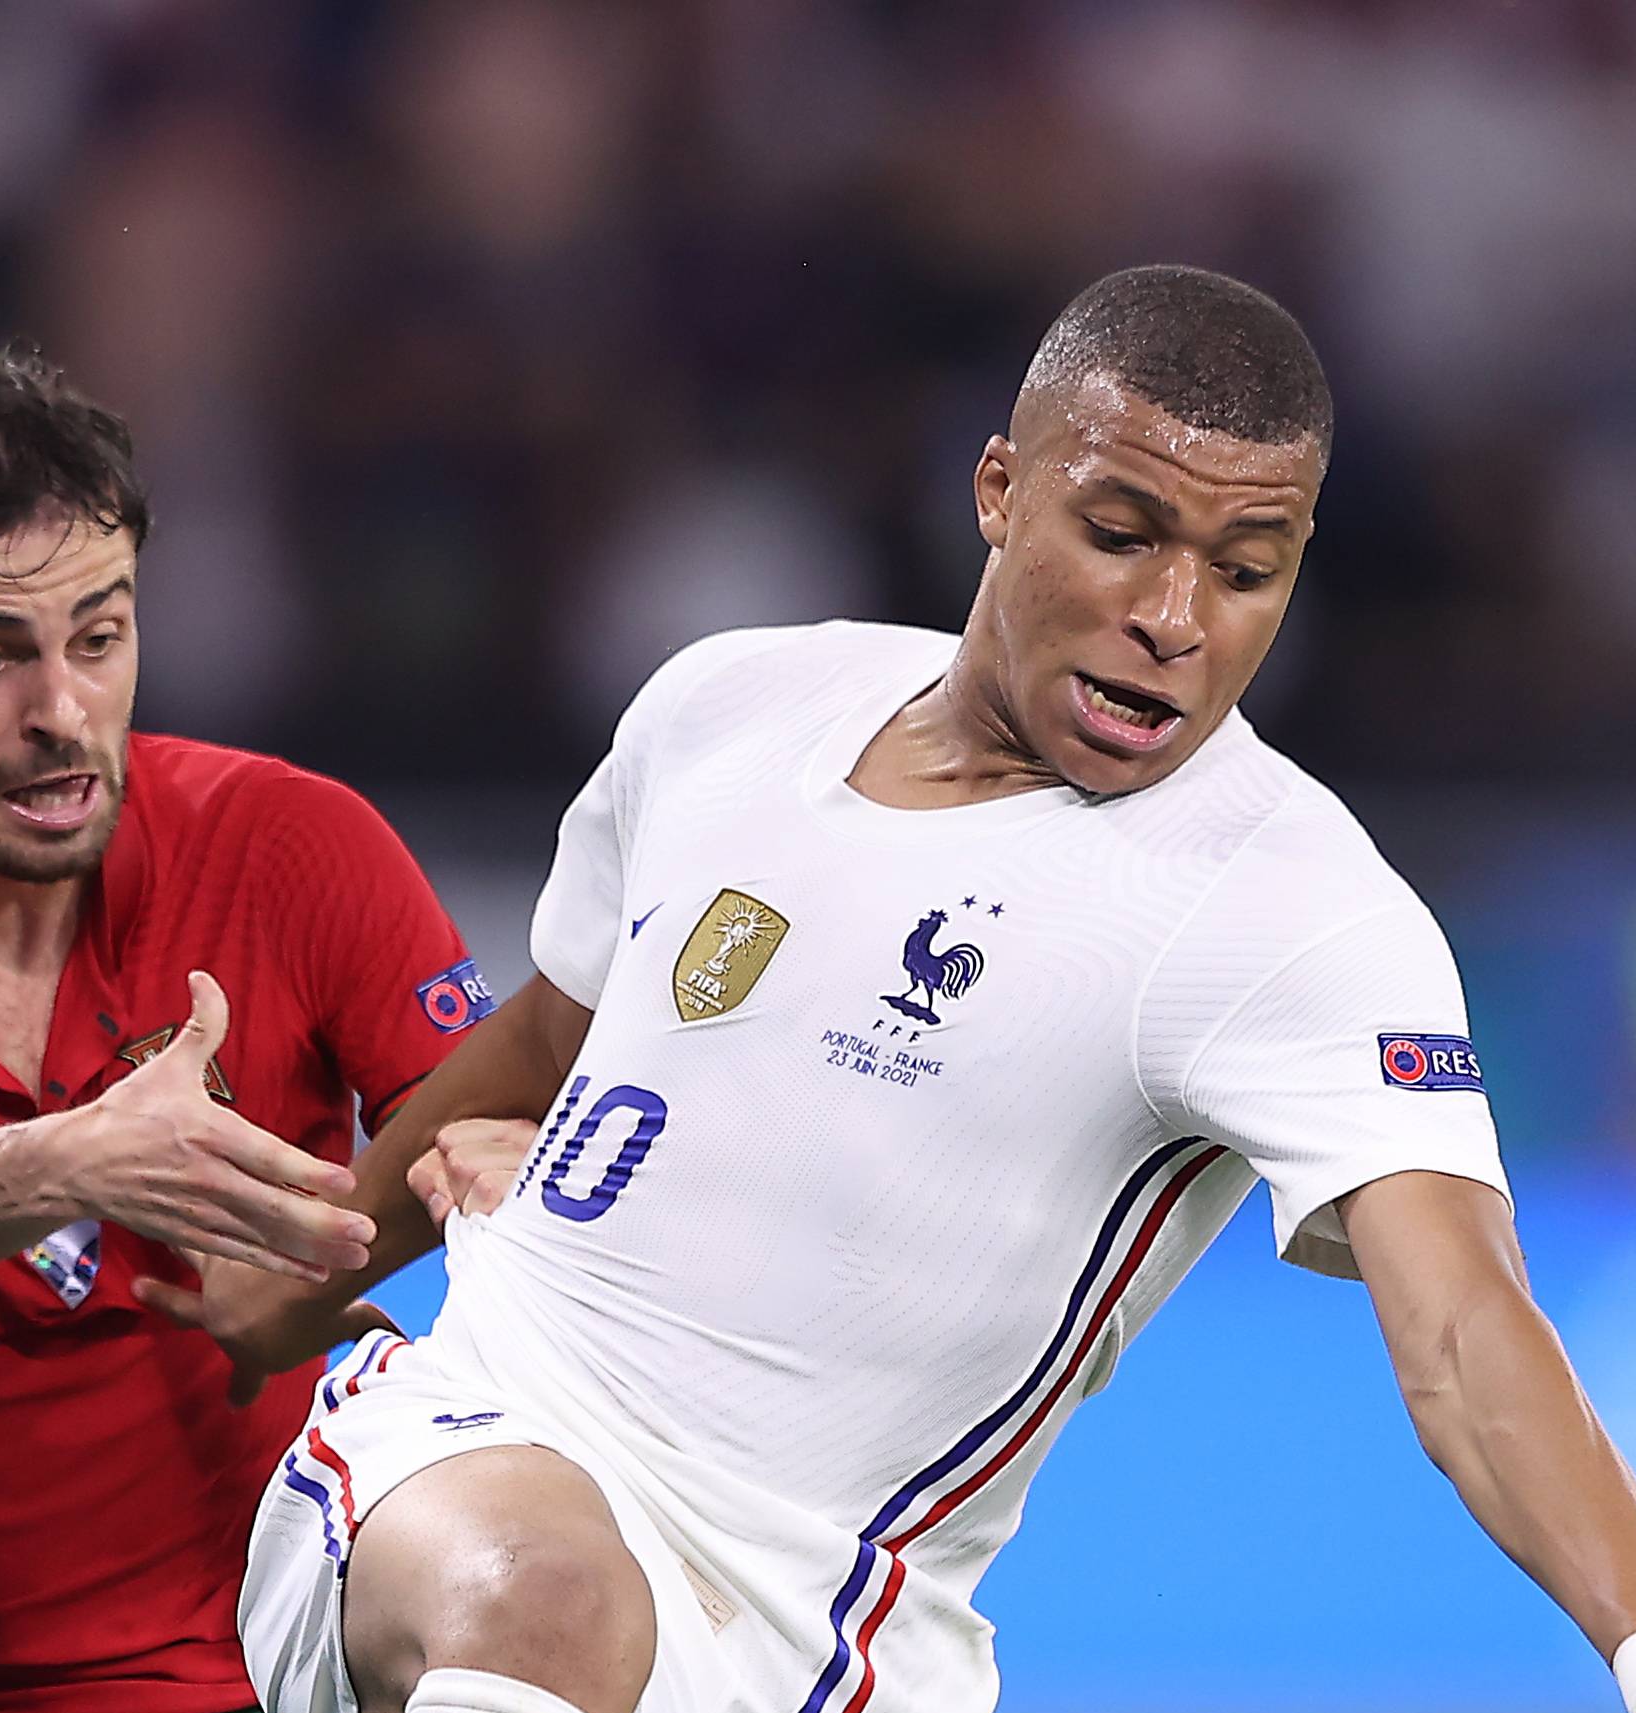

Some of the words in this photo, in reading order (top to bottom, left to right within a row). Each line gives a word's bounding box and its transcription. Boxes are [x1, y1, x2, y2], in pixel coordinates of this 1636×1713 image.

[688, 969, 722, 999] FIFA
[821, 1030, 880, 1060] PORTUGAL
[893, 1051, 944, 1076] FRANCE
[826, 1049, 849, 1067] 23
[849, 1057, 878, 1077] JUIN
[880, 1065, 918, 1087] 2021
[516, 1075, 668, 1223] 10
